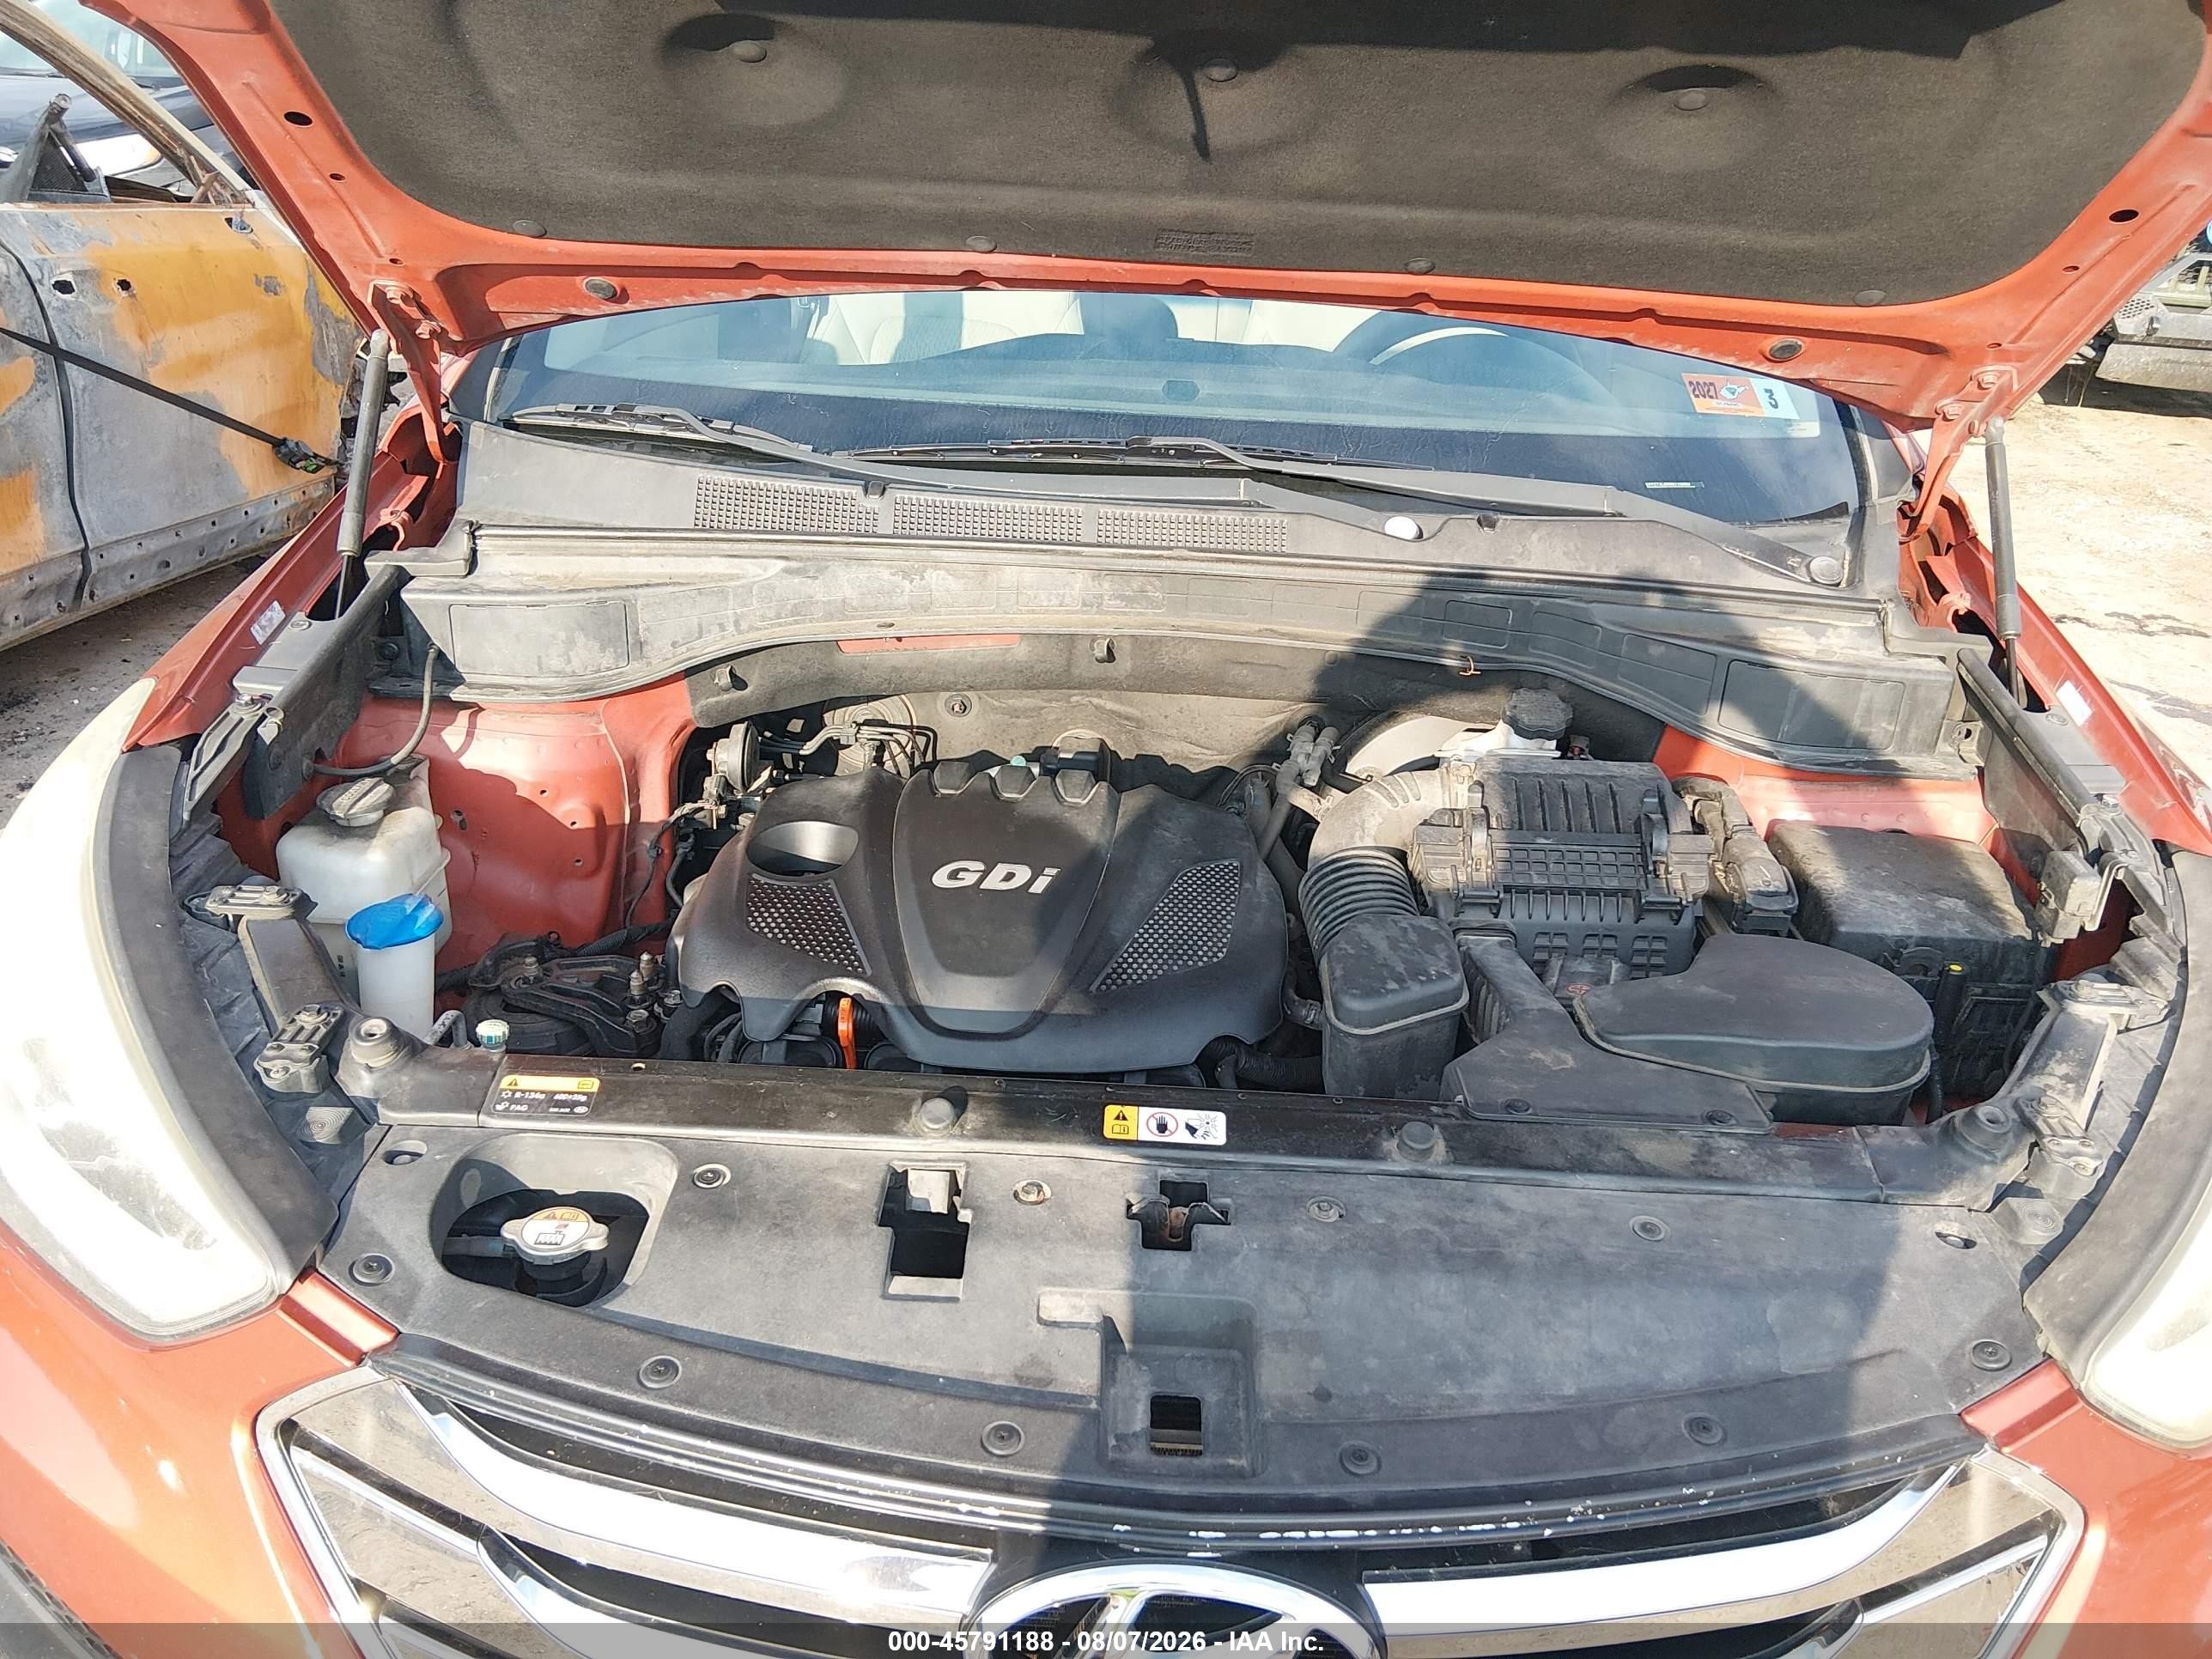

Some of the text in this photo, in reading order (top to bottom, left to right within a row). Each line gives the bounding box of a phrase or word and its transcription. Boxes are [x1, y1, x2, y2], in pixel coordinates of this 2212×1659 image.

[1688, 380, 1718, 399] 2027
[1764, 388, 1779, 410] 3
[931, 860, 1061, 894] GDi
